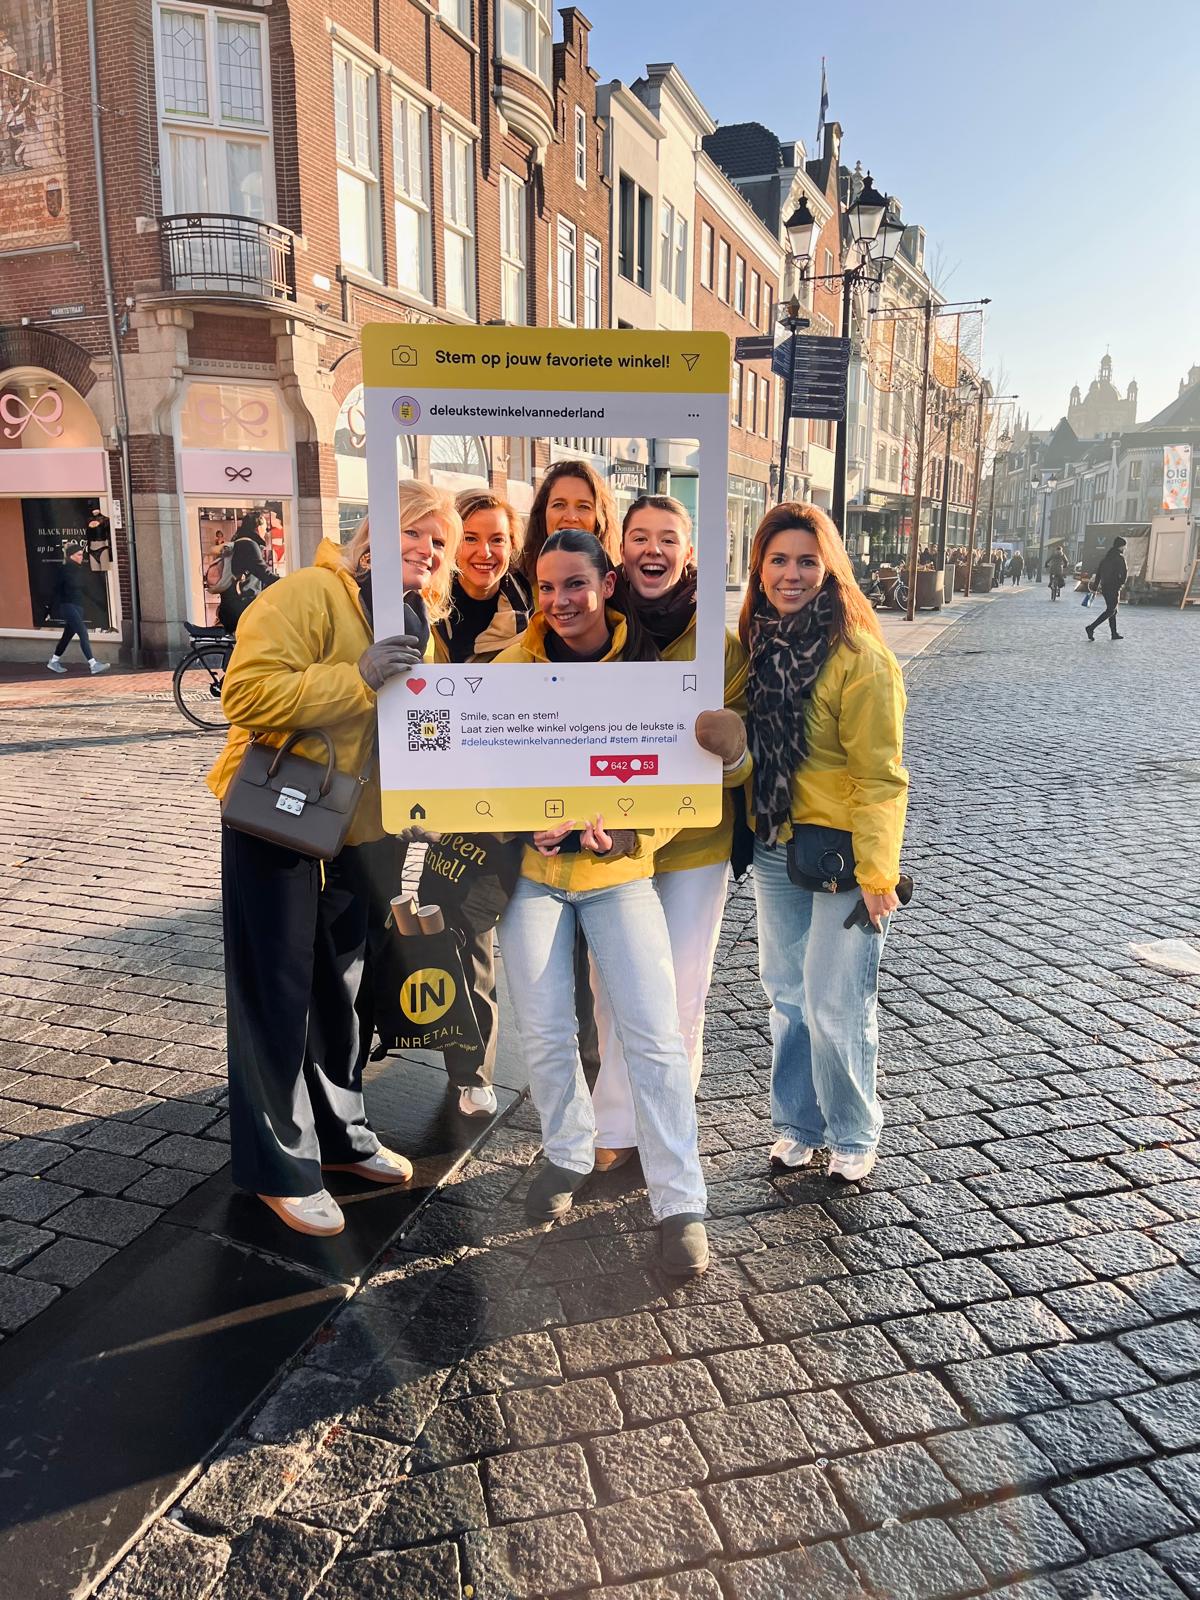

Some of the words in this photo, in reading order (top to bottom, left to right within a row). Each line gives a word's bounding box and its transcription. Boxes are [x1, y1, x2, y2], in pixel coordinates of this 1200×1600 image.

[435, 350, 476, 365] Stem
[482, 353, 501, 369] op
[506, 352, 542, 369] jouw
[546, 352, 614, 368] favoriete
[618, 355, 671, 369] winkel!
[429, 405, 605, 419] deleukstewinkelvannederland
[62, 528, 87, 536] FRIDAY
[460, 712, 490, 721] Smile,
[533, 711, 559, 720] stem!
[424, 726, 434, 735] IN
[461, 725, 482, 734] Laat
[485, 725, 504, 733] zien
[507, 724, 535, 732] welke
[537, 723, 567, 732] winkel
[569, 723, 606, 734] volgens
[608, 723, 623, 733] jou
[625, 723, 638, 731] de
[640, 722, 675, 731] leukste
[676, 722, 687, 731] is.
[461, 736, 607, 747] #deleukstewinkelvannederland
[610, 735, 638, 744] #stem
[641, 734, 678, 744] #inretail
[610, 761, 628, 770] 642
[643, 761, 655, 770] 53
[452, 835, 487, 866] een
[425, 848, 467, 883] inkel!
[409, 978, 446, 1013] IN
[395, 1025, 464, 1048] INRETAIL
